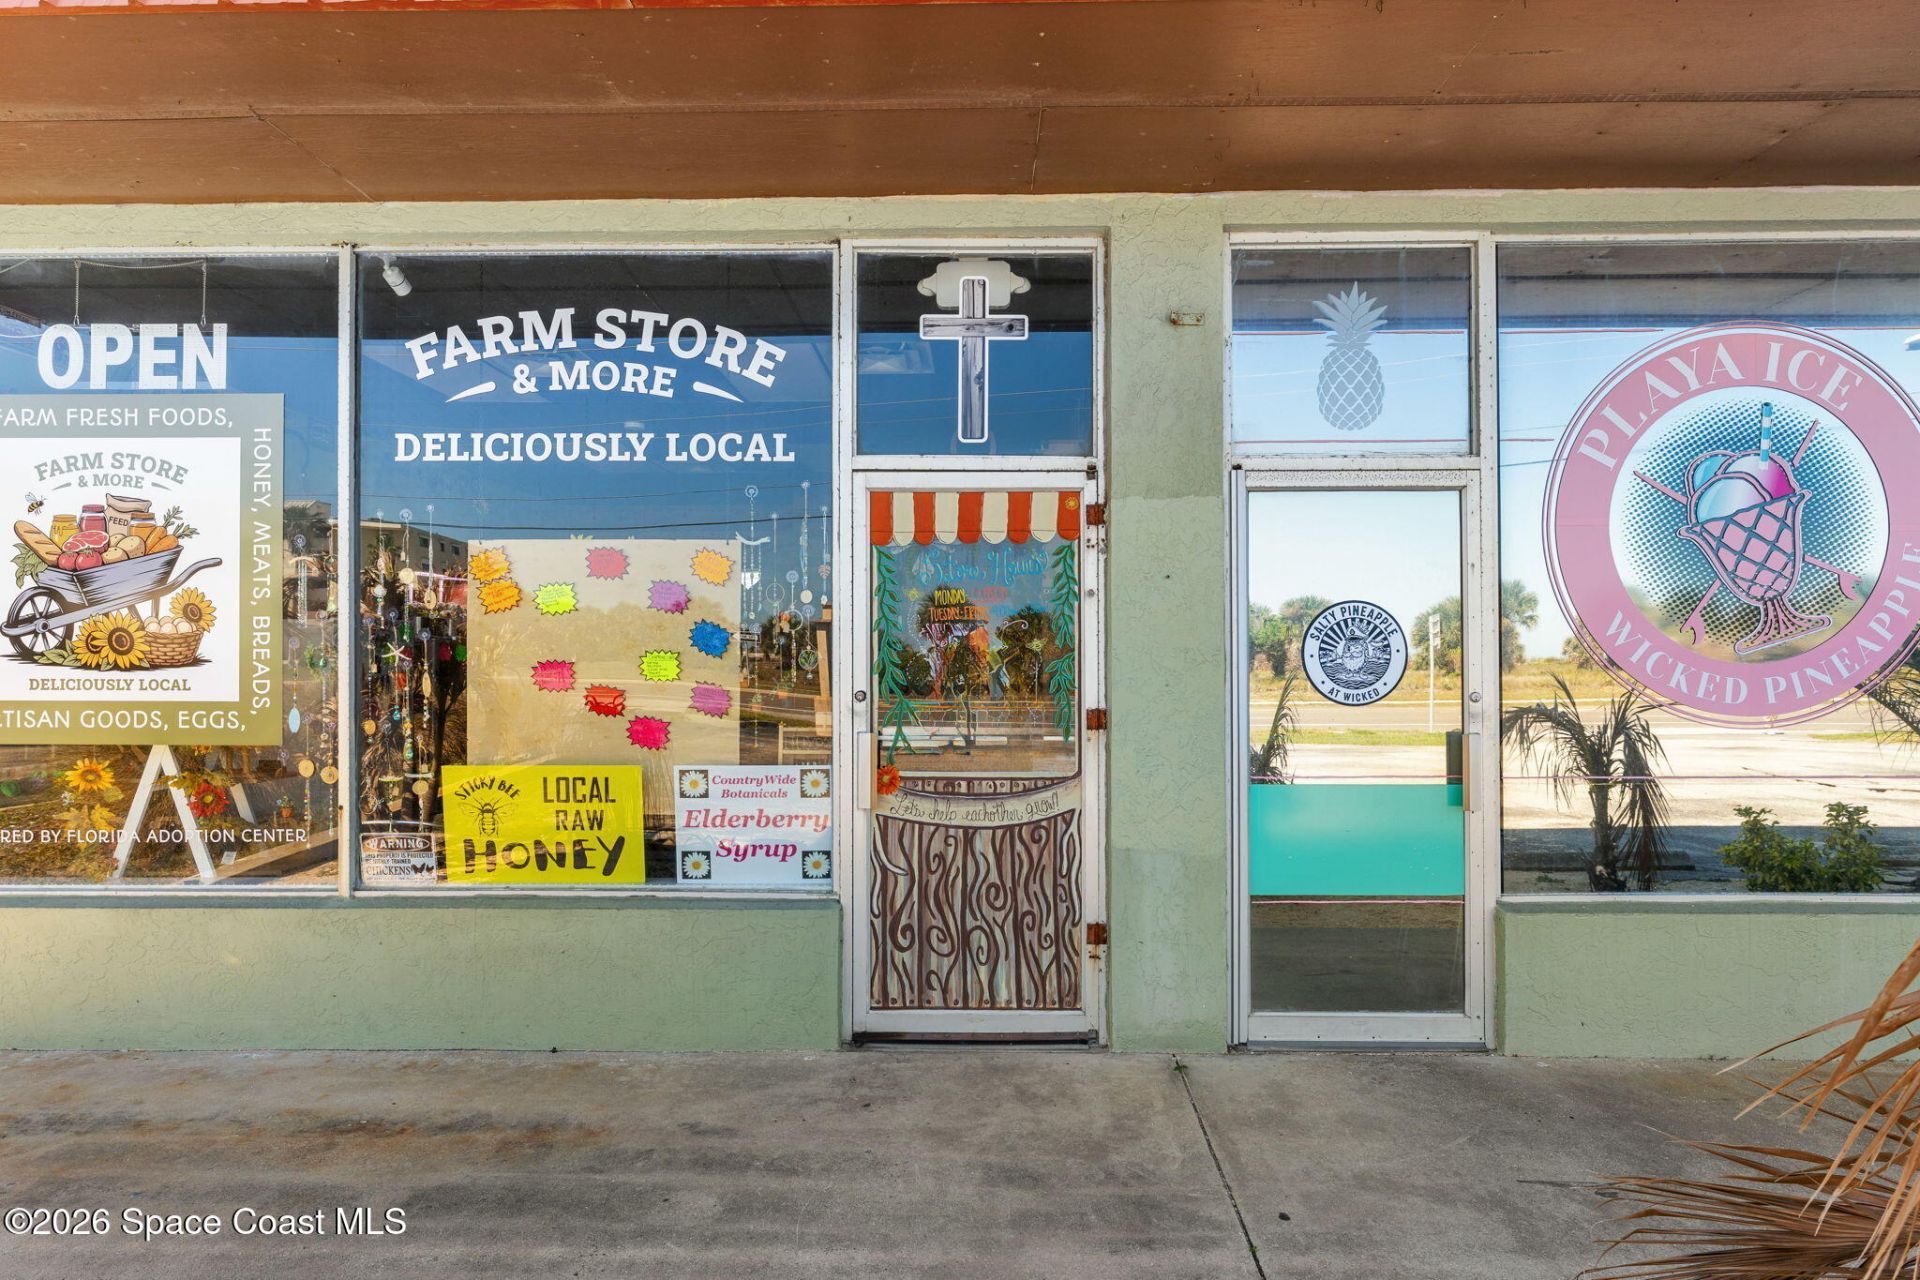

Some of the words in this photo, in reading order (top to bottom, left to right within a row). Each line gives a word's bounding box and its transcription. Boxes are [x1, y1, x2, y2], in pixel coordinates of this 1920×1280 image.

[38, 323, 228, 390] OPEN
[404, 307, 577, 380] FARM
[593, 307, 787, 388] STORE
[512, 363, 539, 394] &
[549, 360, 678, 398] MORE
[0, 408, 58, 427] ARM
[66, 408, 139, 426] FRESH
[149, 408, 234, 428] FOODS,
[1577, 342, 1746, 472] PLAYA
[1762, 341, 1864, 412] ICE
[394, 432, 654, 463] DELICIOUSLY
[666, 432, 796, 463] LOCAL
[34, 452, 104, 482] FARM
[111, 452, 189, 484] STORE
[250, 428, 272, 512] HONEY,
[78, 475, 89, 488] &
[92, 474, 145, 490] MORE
[109, 516, 129, 526] FEED
[250, 521, 272, 605] MEATS,
[1310, 610, 1338, 641] SALTY
[1340, 605, 1398, 638] PINEAPPLE
[249, 616, 271, 715] BREADS,
[1605, 609, 1749, 705] WICKED
[29, 678, 134, 692] DELICIOUSLY
[139, 678, 192, 692] LOCAL
[1328, 687, 1341, 698] AT
[1343, 688, 1380, 702] WICKED
[0, 709, 70, 728] TISAN
[80, 709, 169, 731] GOODS,
[178, 709, 247, 731] EGGS,
[454, 775, 496, 800] STICKY
[543, 776, 616, 804] LOCAL
[721, 788, 789, 799] Botanicals
[928, 799, 957, 822] help
[1025, 791, 1060, 818] grow!
[555, 809, 605, 832] RAW
[682, 808, 830, 832] Elderberry
[41, 829, 61, 843] BY
[67, 829, 140, 843] FLORIDA
[147, 829, 237, 843] ADOPTION
[241, 829, 307, 843] CENTER
[369, 838, 424, 849] WARNING
[462, 835, 626, 877] HONEY
[715, 838, 798, 863] Syrup
[366, 865, 411, 876] CHICKENS
